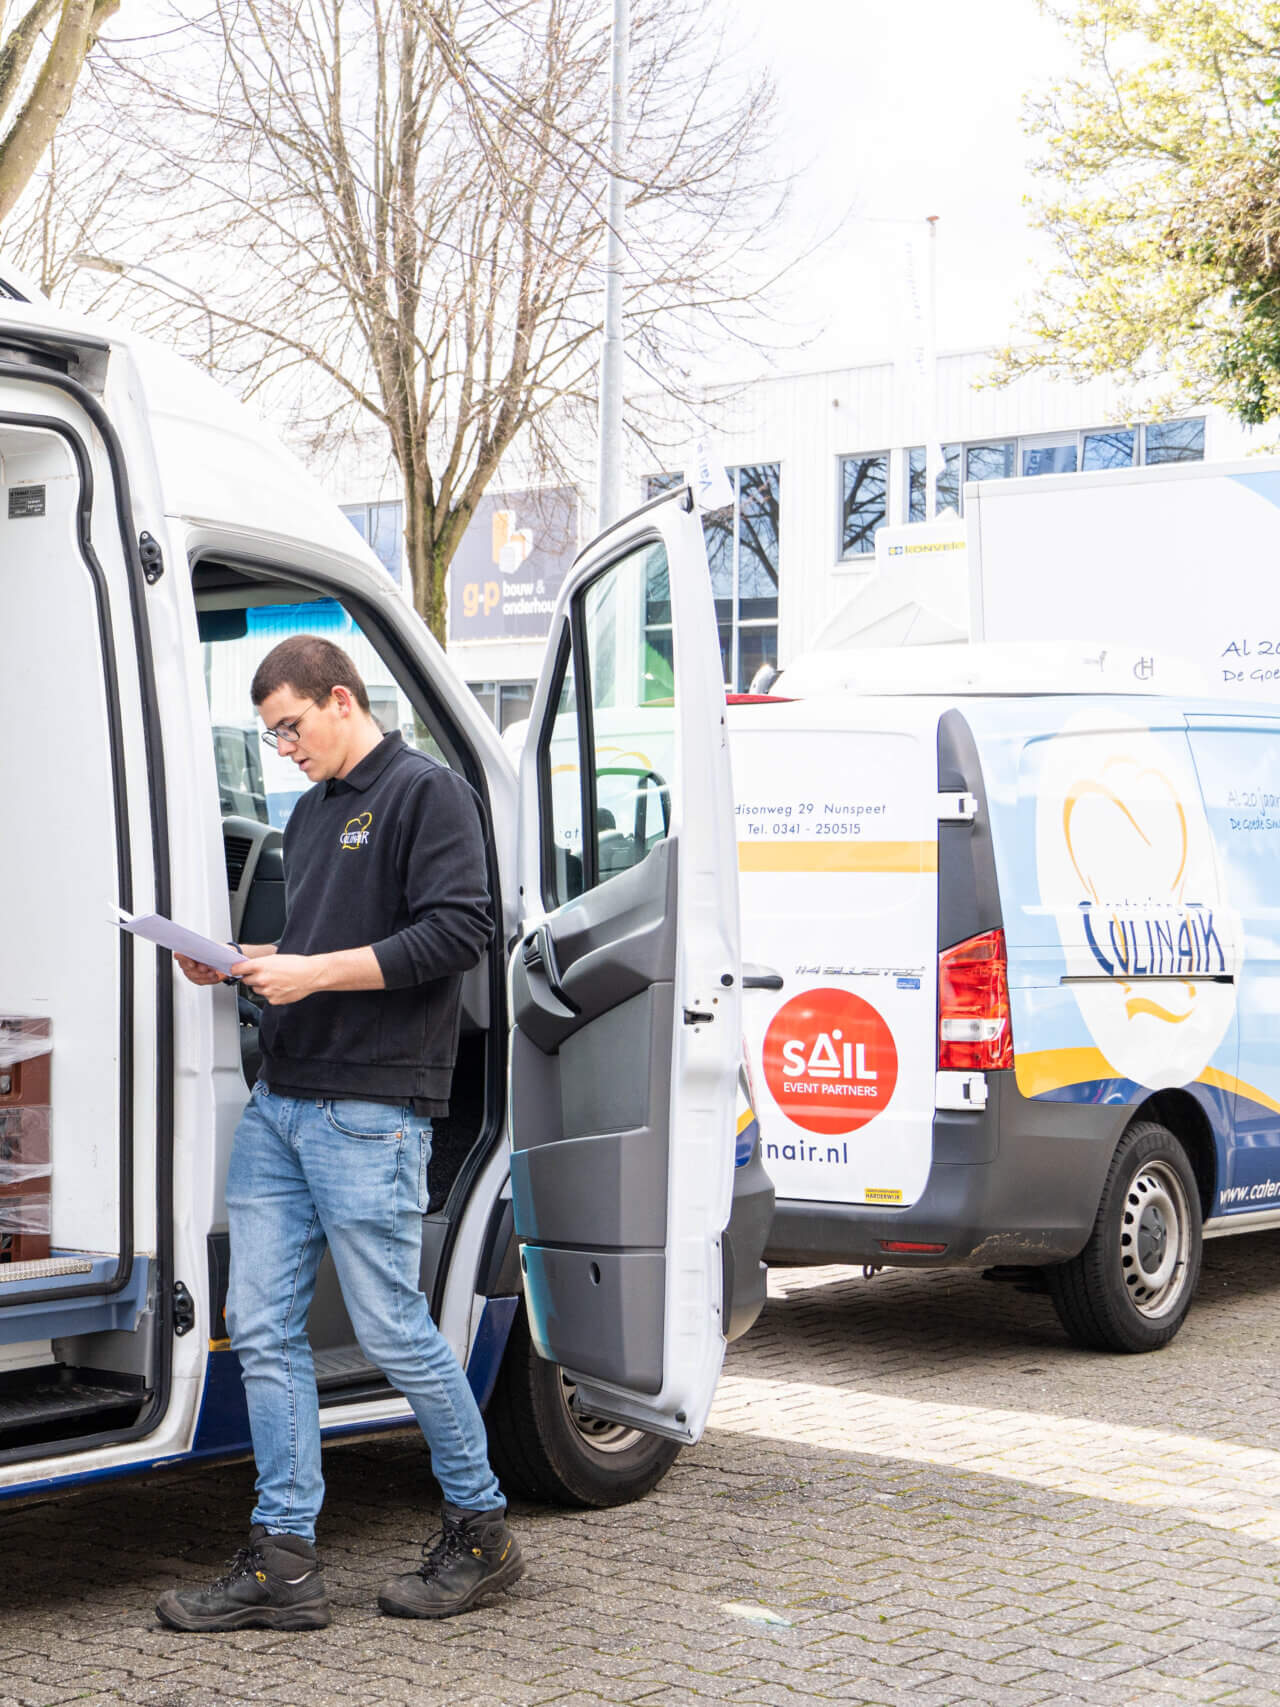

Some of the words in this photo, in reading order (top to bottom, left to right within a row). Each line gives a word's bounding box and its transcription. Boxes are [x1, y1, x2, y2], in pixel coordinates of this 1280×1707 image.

[502, 579, 535, 598] bouw
[536, 578, 545, 595] &
[1221, 639, 1251, 658] Al
[1222, 669, 1245, 682] De
[798, 802, 815, 815] 29
[823, 803, 887, 817] Nunspeet
[747, 823, 768, 835] Tel.
[772, 823, 801, 835] 0341
[815, 823, 862, 835] 250515
[782, 1028, 878, 1081] SAIL
[783, 1081, 819, 1094] EVENT
[821, 1083, 879, 1098] PARTNERS
